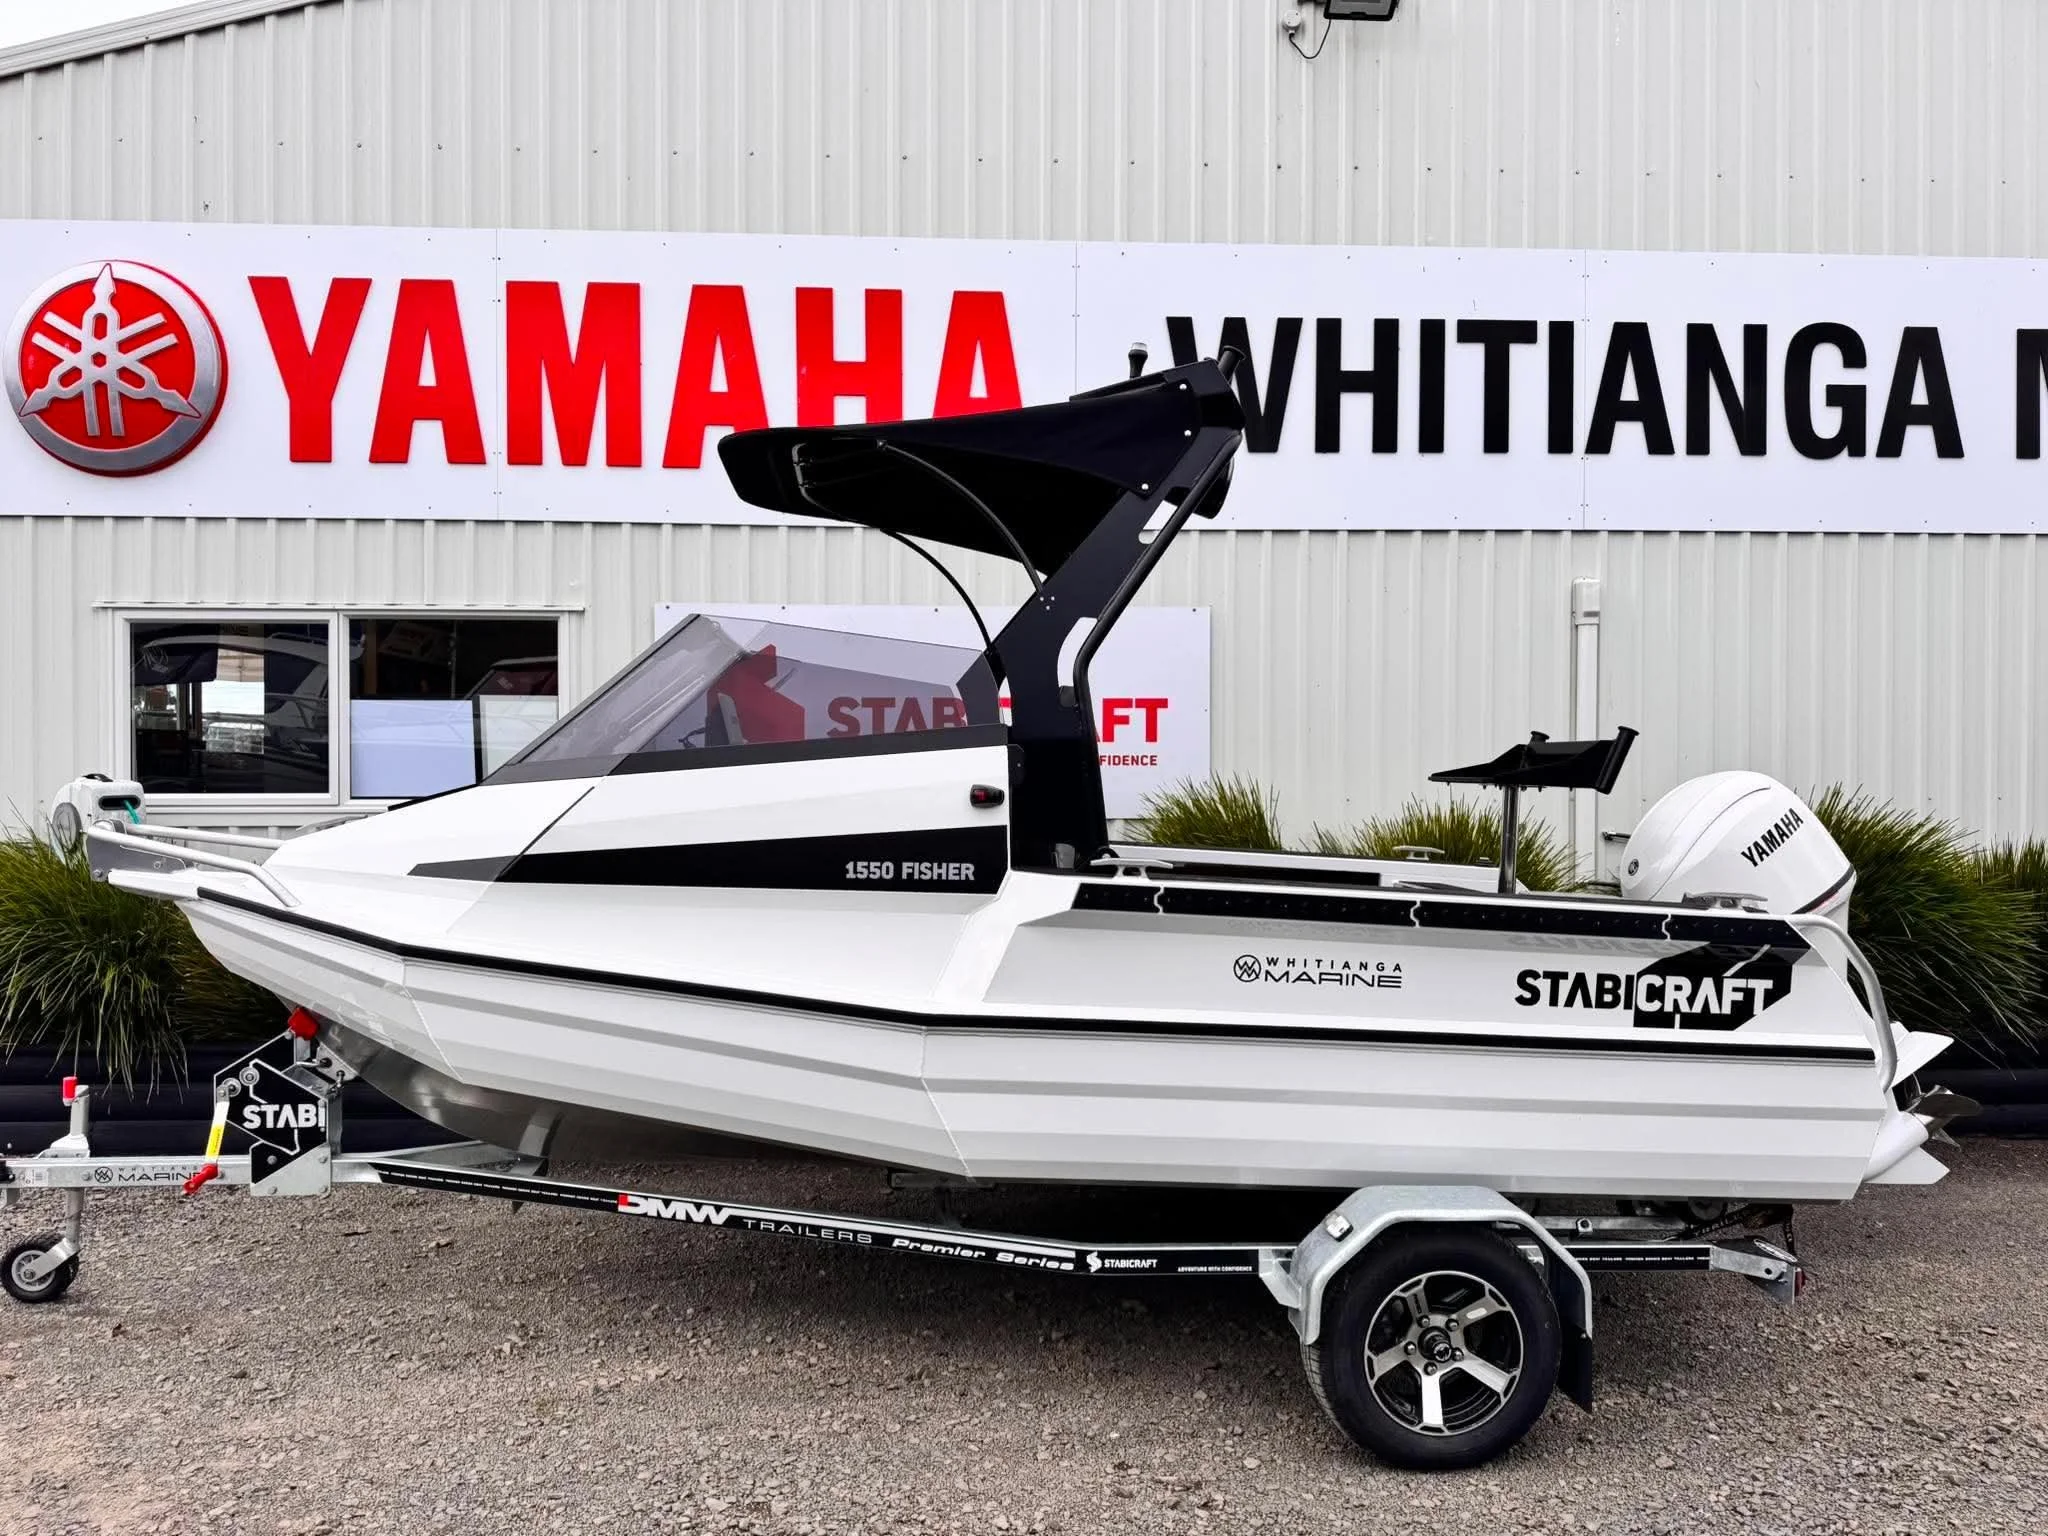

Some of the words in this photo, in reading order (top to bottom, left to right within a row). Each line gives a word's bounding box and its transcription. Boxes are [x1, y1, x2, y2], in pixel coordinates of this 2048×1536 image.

[248, 275, 1023, 468] YAMAHA
[1099, 754, 1158, 766] FIDENCE
[1740, 808, 1804, 868] YAMAHA
[845, 861, 895, 879] 1550
[901, 861, 975, 880] FISHER
[1265, 956, 1402, 973] WHITIANGA
[1264, 969, 1402, 989] MARINE
[1514, 968, 1774, 1015] STABICRAFT
[743, 1218, 872, 1244] TRAILERS
[891, 1237, 986, 1258] Premier
[995, 1251, 1075, 1271] Series
[1103, 1258, 1158, 1269] STABICRAFT
